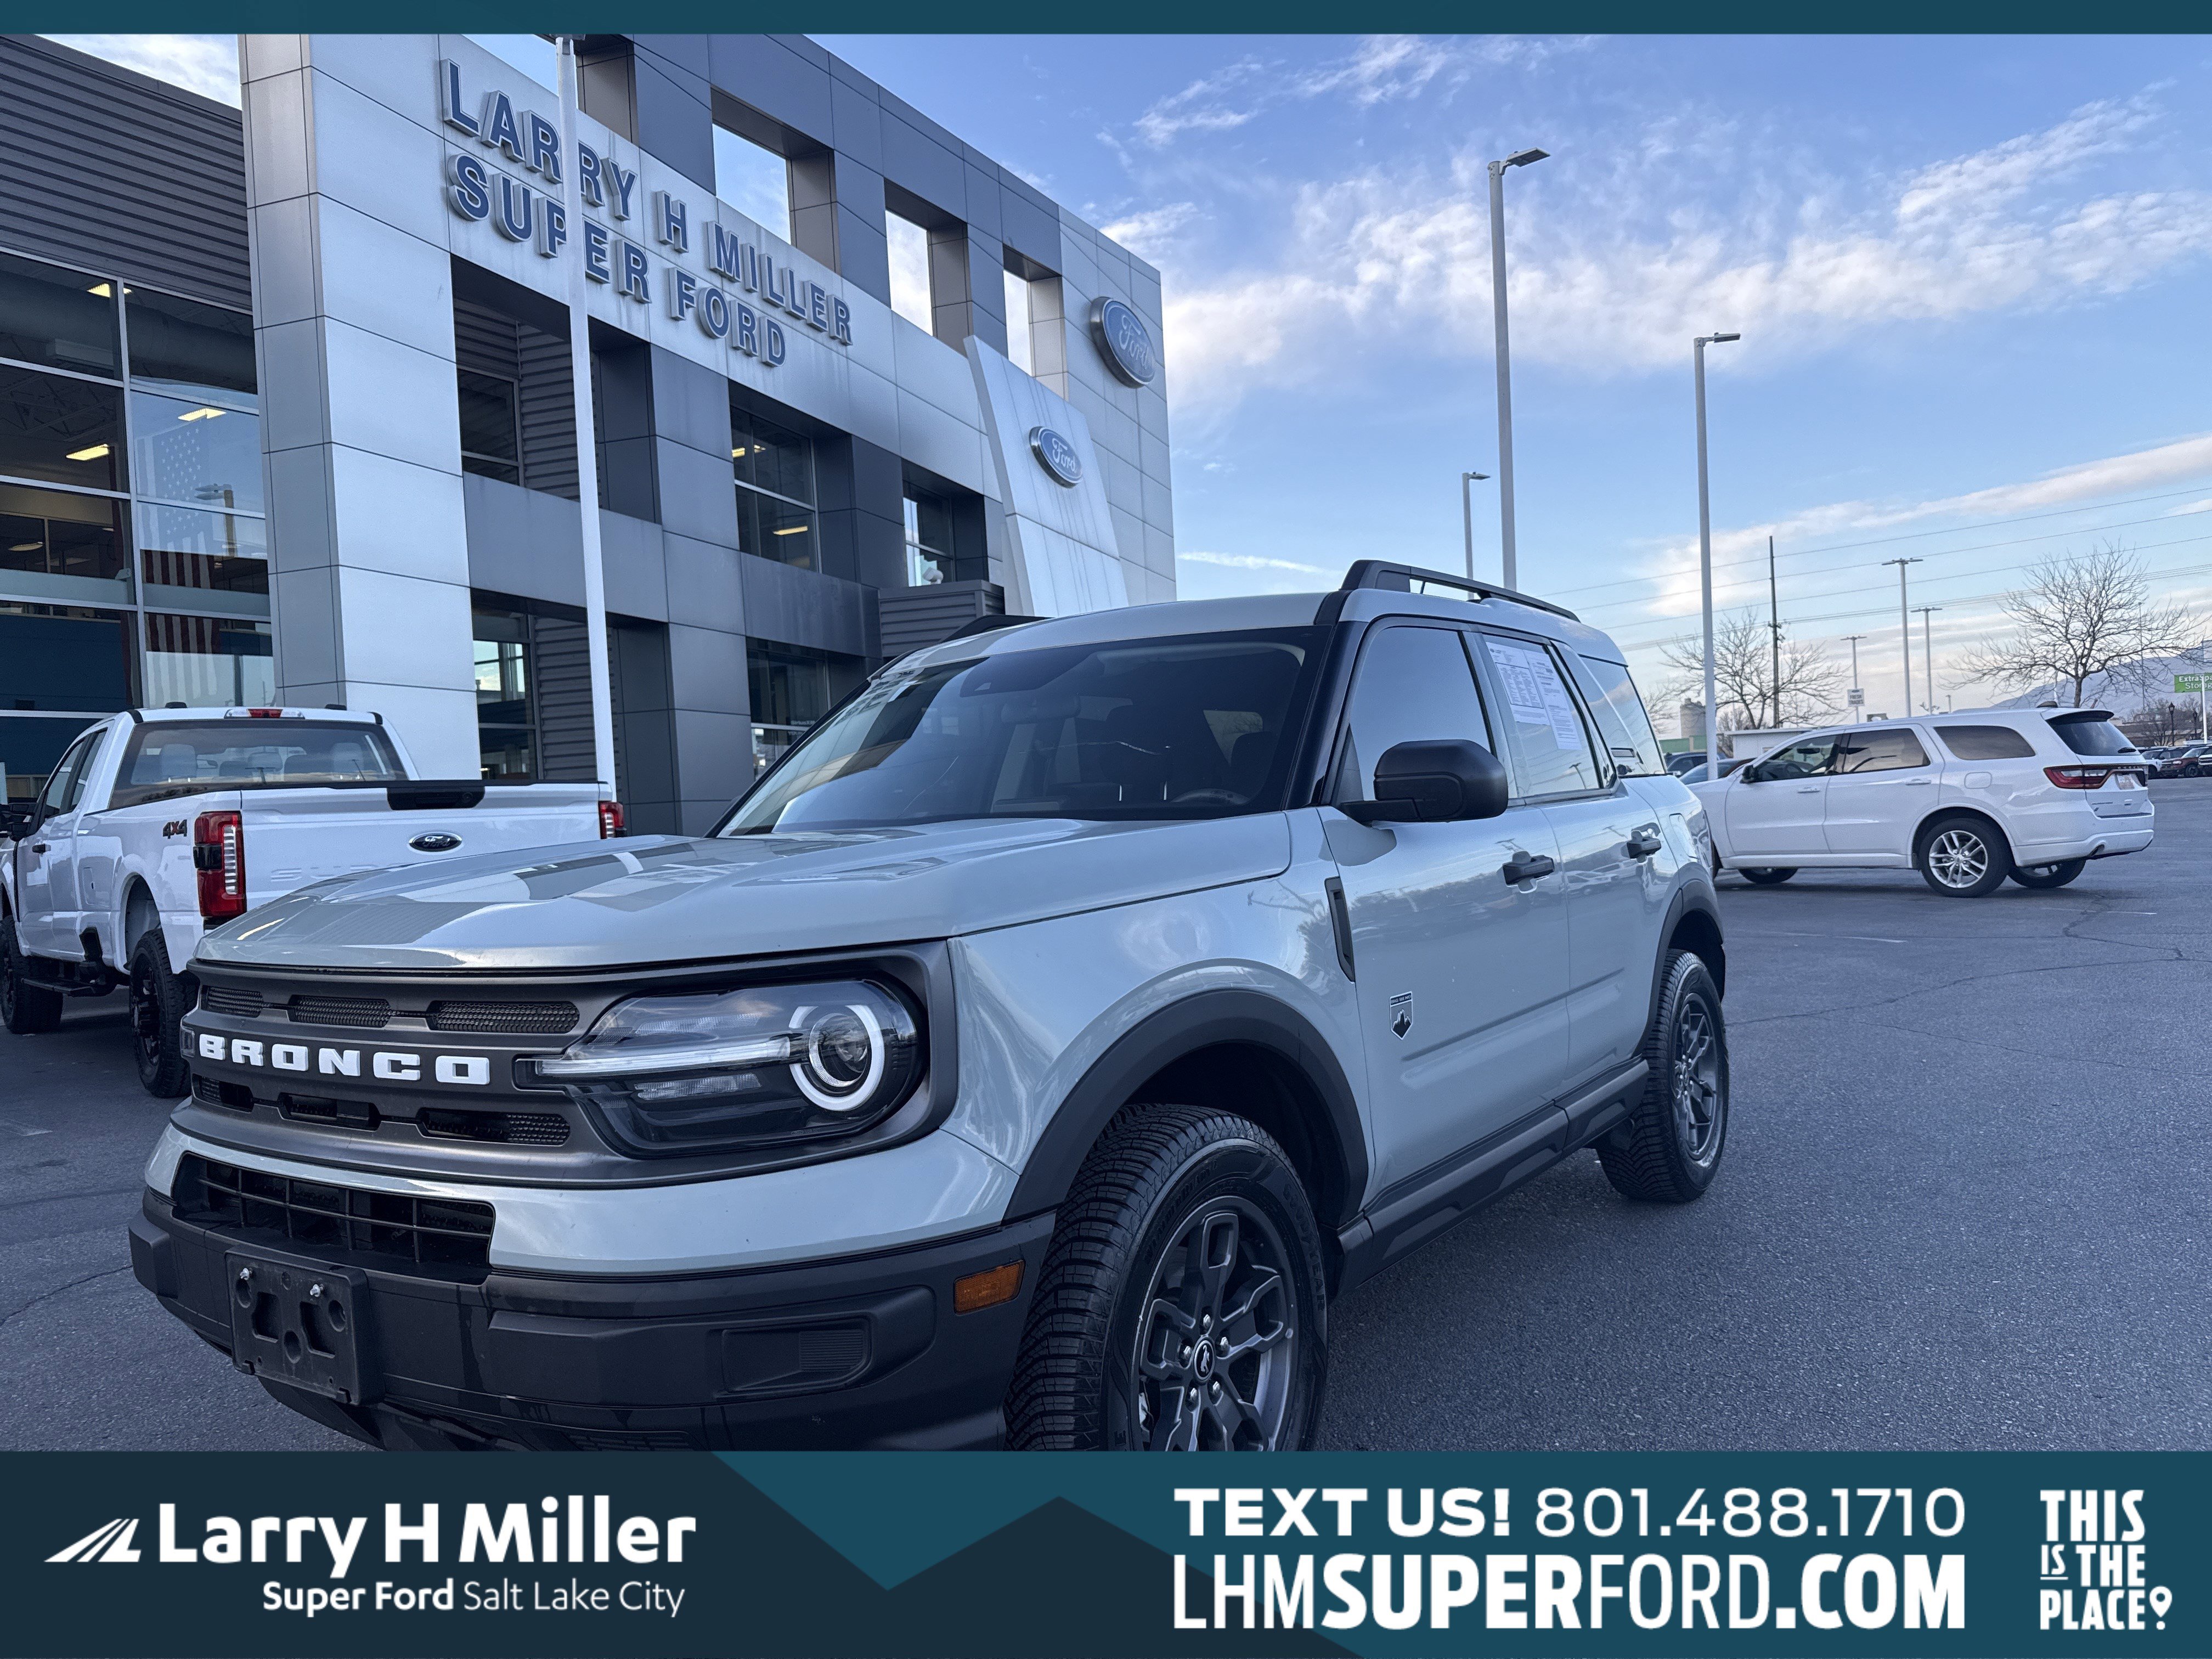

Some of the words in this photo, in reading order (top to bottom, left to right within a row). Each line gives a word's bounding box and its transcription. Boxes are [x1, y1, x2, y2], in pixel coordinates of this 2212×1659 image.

[441, 58, 637, 221] LARRY
[658, 190, 689, 253] H
[708, 221, 854, 346] MILLER
[447, 154, 652, 303] SUPER
[670, 267, 787, 368] FORD
[1119, 314, 1149, 371] Ford
[1052, 438, 1076, 474] Ford
[422, 836, 450, 848] Ford
[199, 1033, 490, 1086] BRONCO
